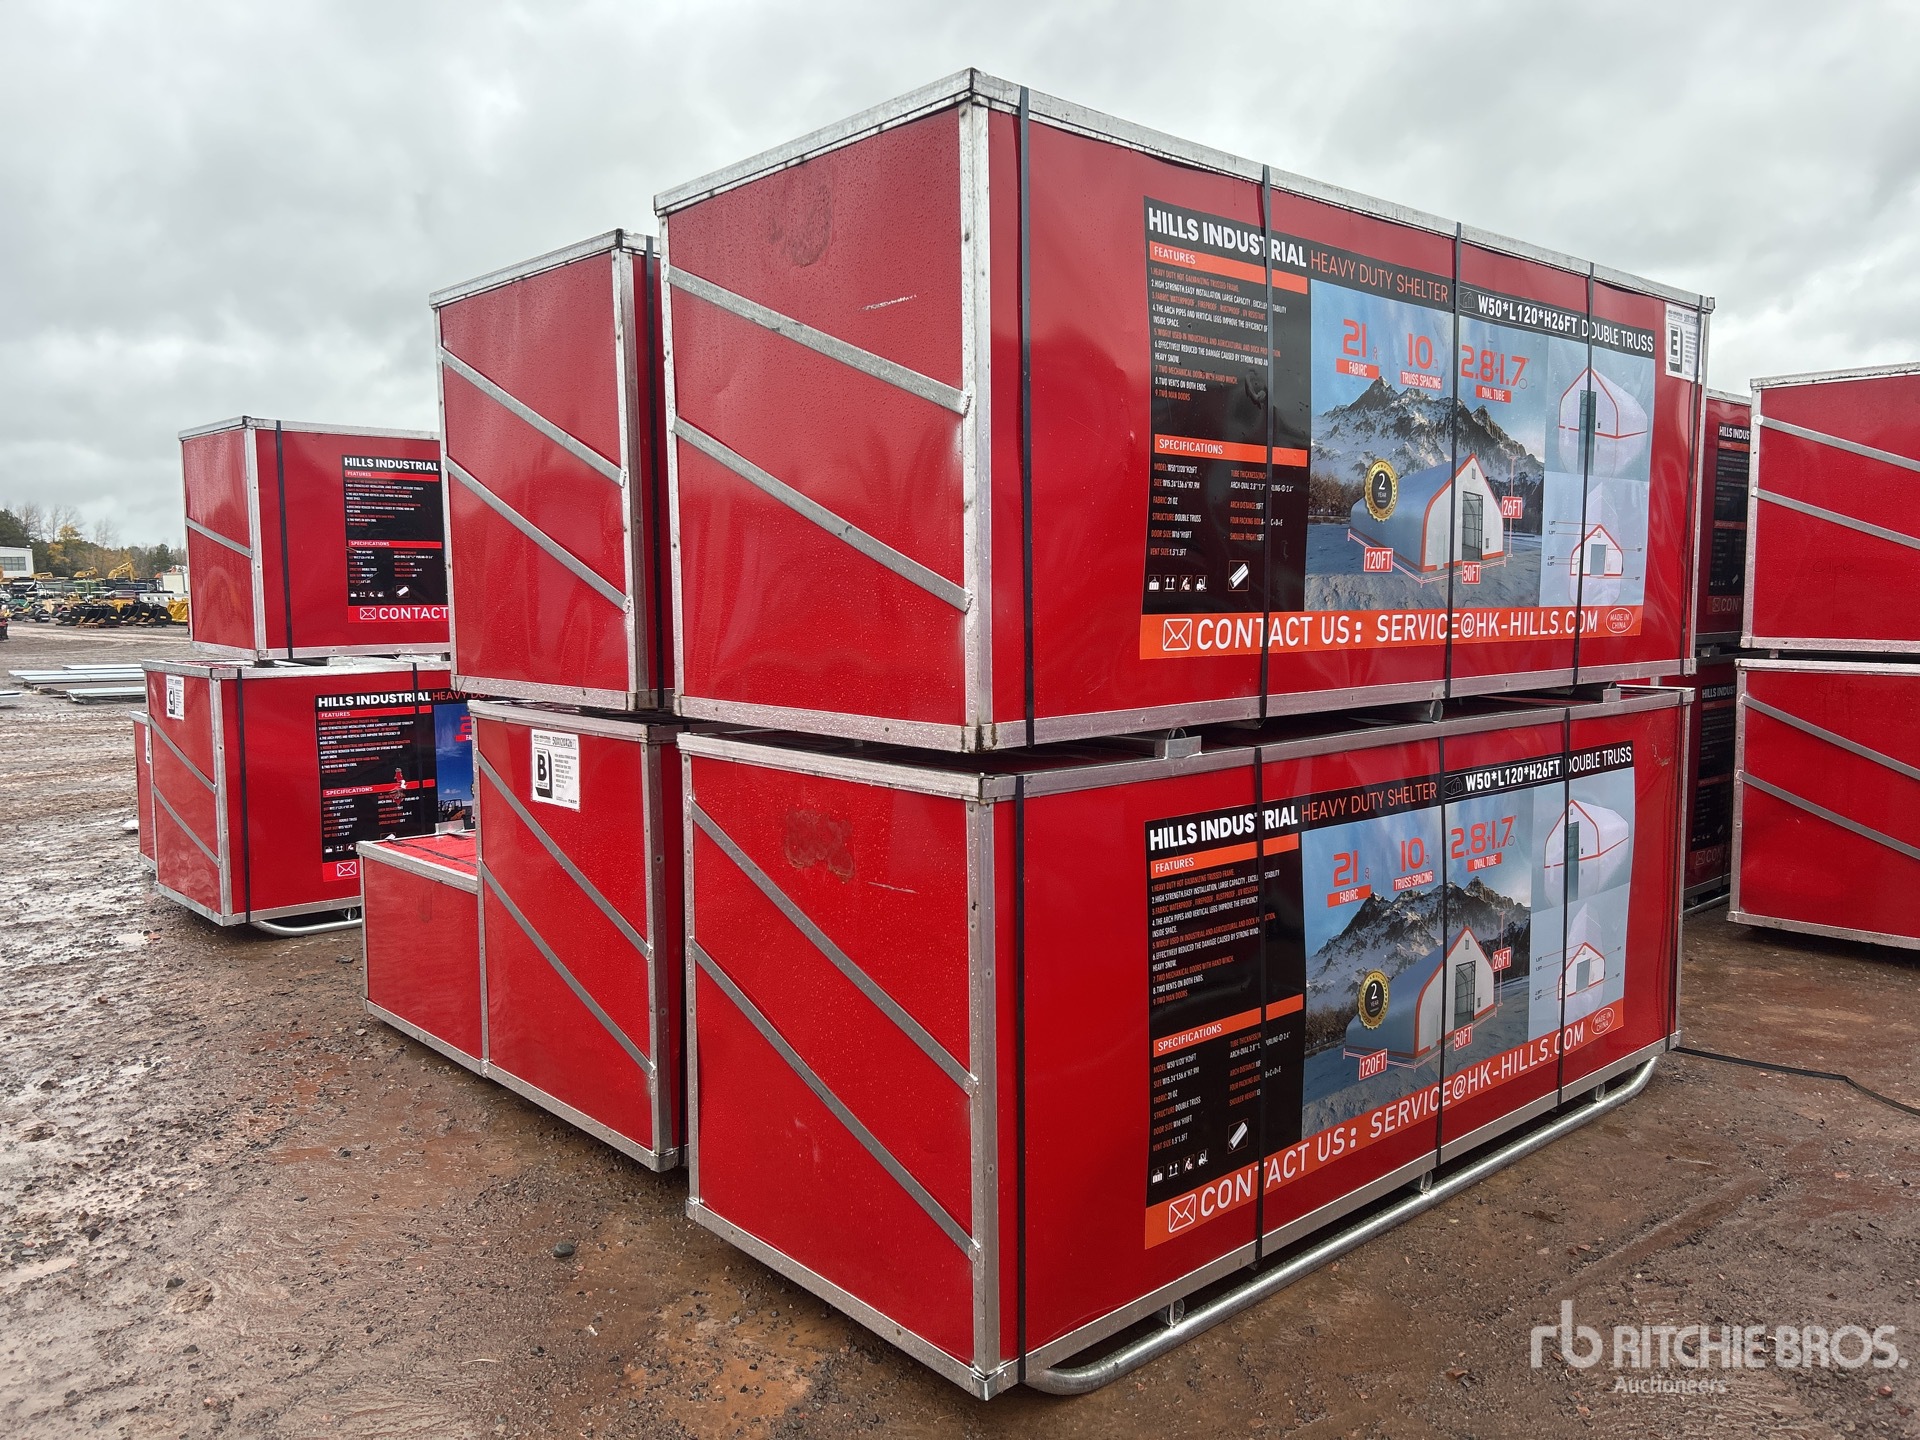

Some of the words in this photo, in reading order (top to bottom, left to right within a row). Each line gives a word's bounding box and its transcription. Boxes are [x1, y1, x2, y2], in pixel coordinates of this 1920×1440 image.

[1154, 246, 1196, 264] FEATURES
[1148, 207, 1199, 241] HILLS
[1203, 222, 1306, 267] INDUSTRIAL
[1310, 250, 1355, 279] HEAVY
[1360, 264, 1393, 290] DUTY
[1396, 275, 1448, 303] SHELTER
[1582, 321, 1618, 346] DOUBLE
[1621, 330, 1653, 352] TRUSS
[1343, 318, 1367, 358] 21
[1671, 330, 1678, 356] E
[1408, 333, 1433, 370] 10
[1402, 372, 1418, 386] TRUSS
[1419, 375, 1441, 390] SPACING
[1481, 386, 1493, 399] OVAL
[1494, 388, 1505, 401] TUBE
[1719, 426, 1732, 438] HILLS
[1733, 428, 1750, 440] INDUS
[1159, 439, 1223, 454] SPECIFICATIONS
[344, 457, 374, 467] HILLS
[376, 459, 438, 471] INDUSTRIAL
[1379, 473, 1385, 490] 2
[1503, 500, 1522, 516] 26FT
[1366, 551, 1392, 569] 120FT
[1463, 565, 1480, 582] 50FT
[379, 607, 448, 619] CONTACT
[1610, 614, 1624, 622] MADE
[1197, 616, 1312, 650] CONTACT
[1322, 616, 1361, 644] US:
[1376, 610, 1597, 642] SERVICE@HK-HILLS.COM
[1612, 622, 1627, 630] CHINA
[318, 696, 354, 707] HILLS
[357, 692, 431, 705] INDUSTRIAL
[433, 691, 467, 701] HEAVY
[1702, 687, 1716, 698] HILLS
[1717, 685, 1736, 697] INDUST
[538, 754, 547, 781] B
[326, 787, 373, 795] SPECIFICATIONS
[1150, 823, 1197, 850] HILLS
[1302, 798, 1347, 822] HEAVY
[1351, 790, 1384, 814] DUTY
[1388, 782, 1437, 807] SHELTER
[1602, 746, 1632, 766] TRUSS
[1401, 837, 1424, 872] 10
[1474, 860, 1485, 870] OVAL
[1486, 855, 1497, 867] TUBE
[1155, 857, 1194, 873] FEATURES
[1333, 850, 1358, 887] 21
[1395, 877, 1411, 890] TRUSS
[1412, 870, 1433, 887] SPACING
[1494, 949, 1511, 970] 26FT
[1371, 983, 1377, 999] 2
[1594, 1013, 1605, 1024] MADE
[1596, 1019, 1609, 1029] CHINA
[1158, 1024, 1222, 1051] SPECIFICATIONS
[1455, 1027, 1472, 1048] 50FT
[1361, 1052, 1386, 1077] 120FT
[1317, 1128, 1356, 1161] US:
[1370, 1022, 1584, 1138] SERVICE@HK-HILLS.COM
